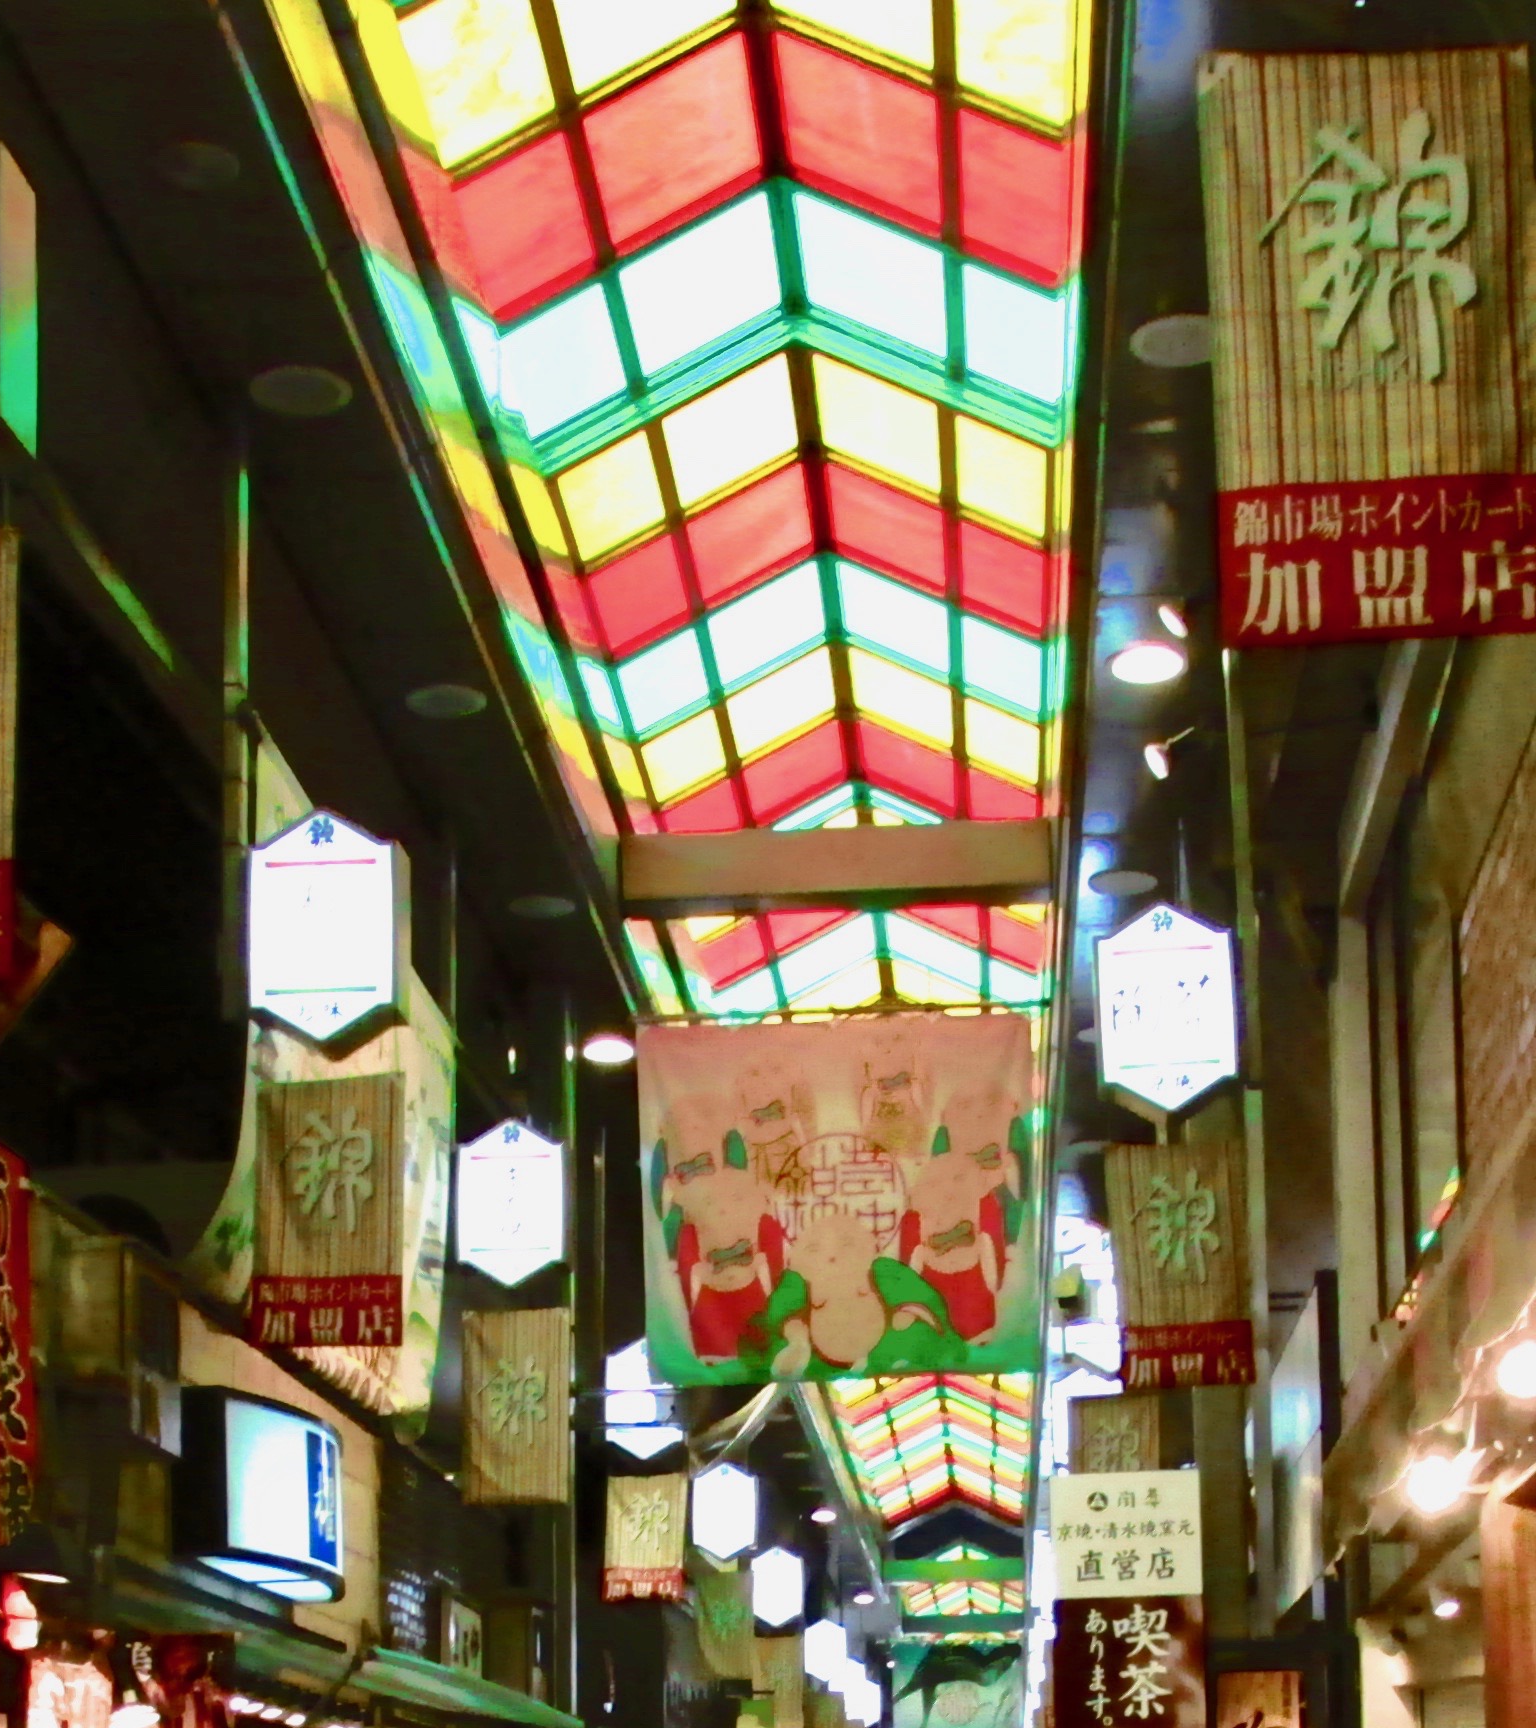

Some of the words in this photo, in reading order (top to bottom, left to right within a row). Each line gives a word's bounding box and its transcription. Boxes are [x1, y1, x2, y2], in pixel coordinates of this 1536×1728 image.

[1260, 107, 1477, 385] 錦
[1236, 540, 1536, 635] 加盟店
[281, 1105, 375, 1233] 錦
[1129, 1168, 1221, 1287] 錦
[1077, 1547, 1175, 1582] 直営店
[1084, 1608, 1114, 1727] あります。
[1113, 1604, 1172, 1720] 喫茶
